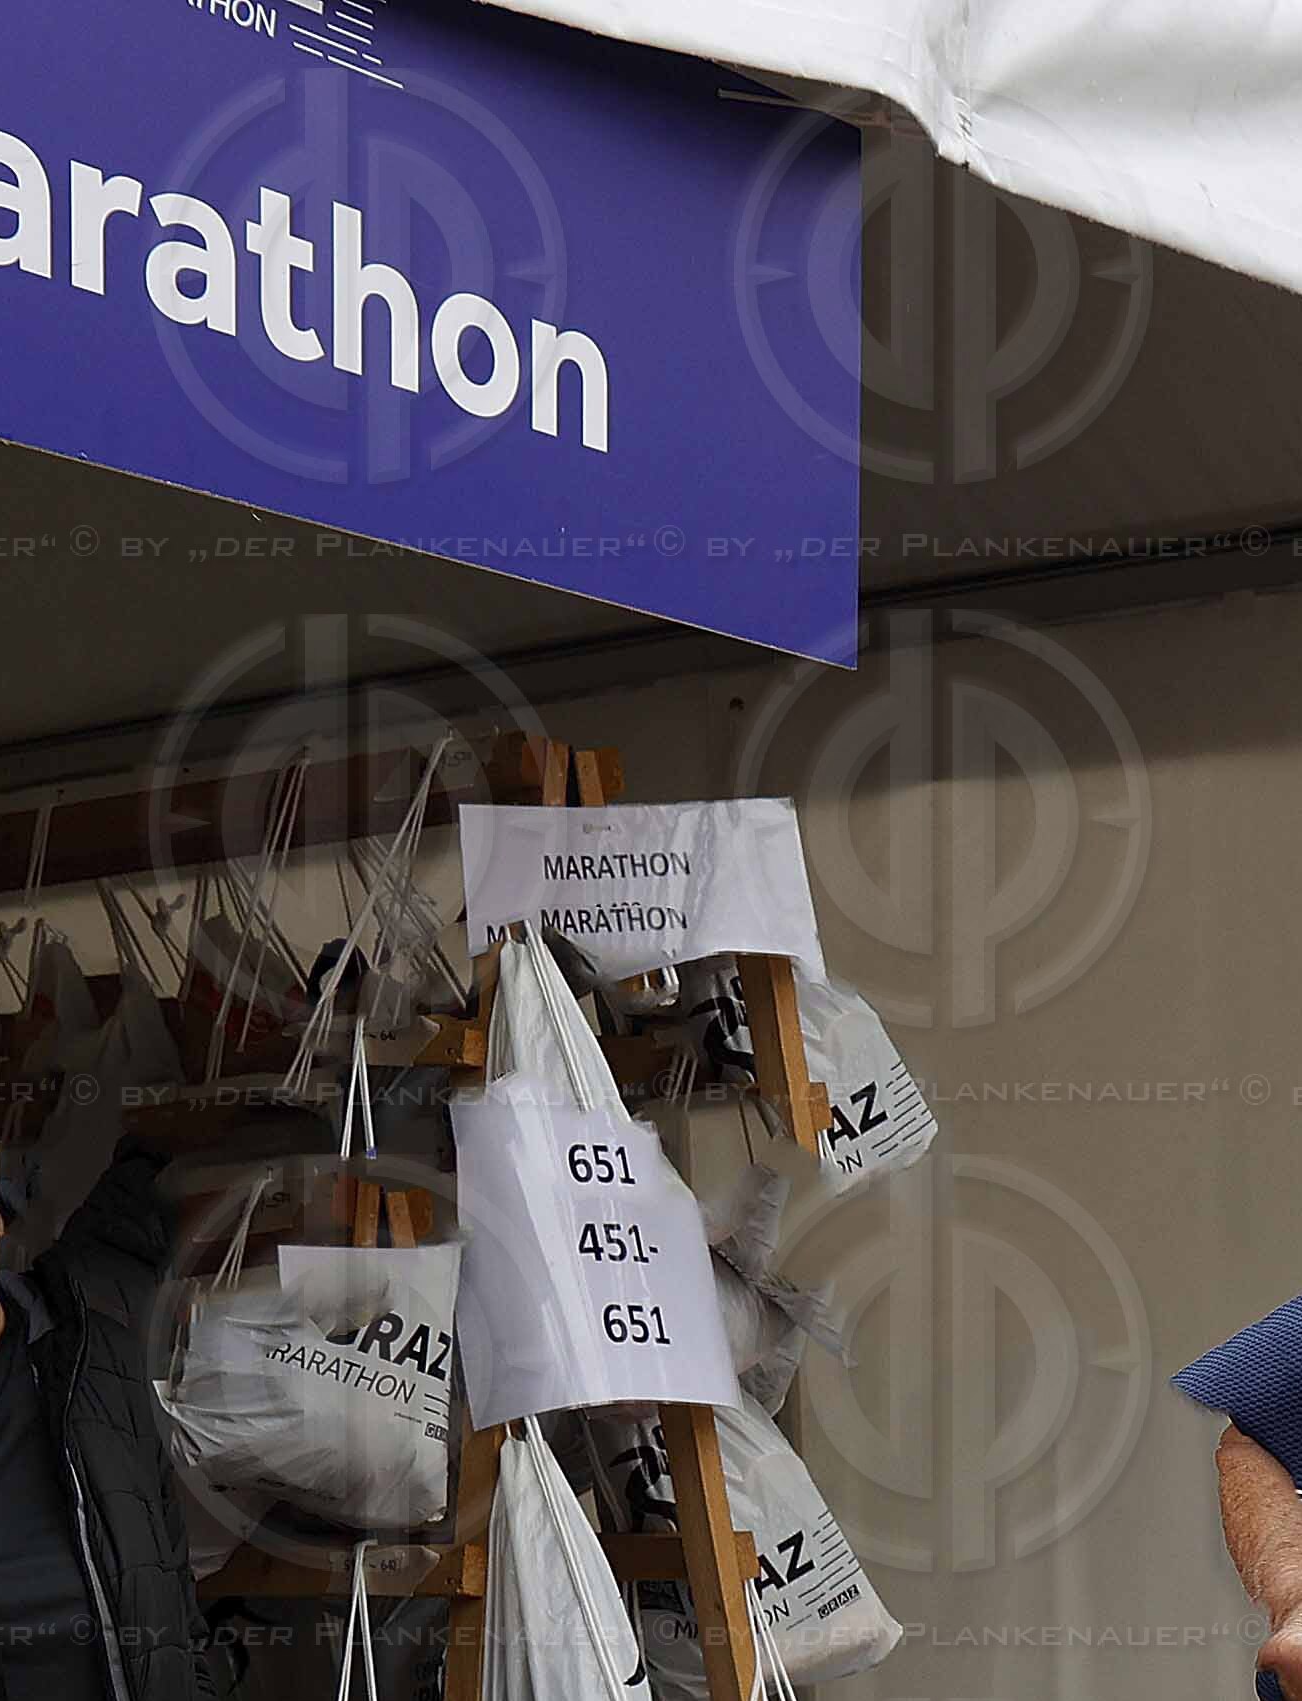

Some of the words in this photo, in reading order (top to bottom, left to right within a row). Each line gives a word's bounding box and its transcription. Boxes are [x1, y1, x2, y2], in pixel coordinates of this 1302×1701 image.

[544, 852, 691, 881] MARATHON
[568, 1144, 636, 1186] 651
[578, 1223, 658, 1265] 451-
[603, 1304, 671, 1346] 651
